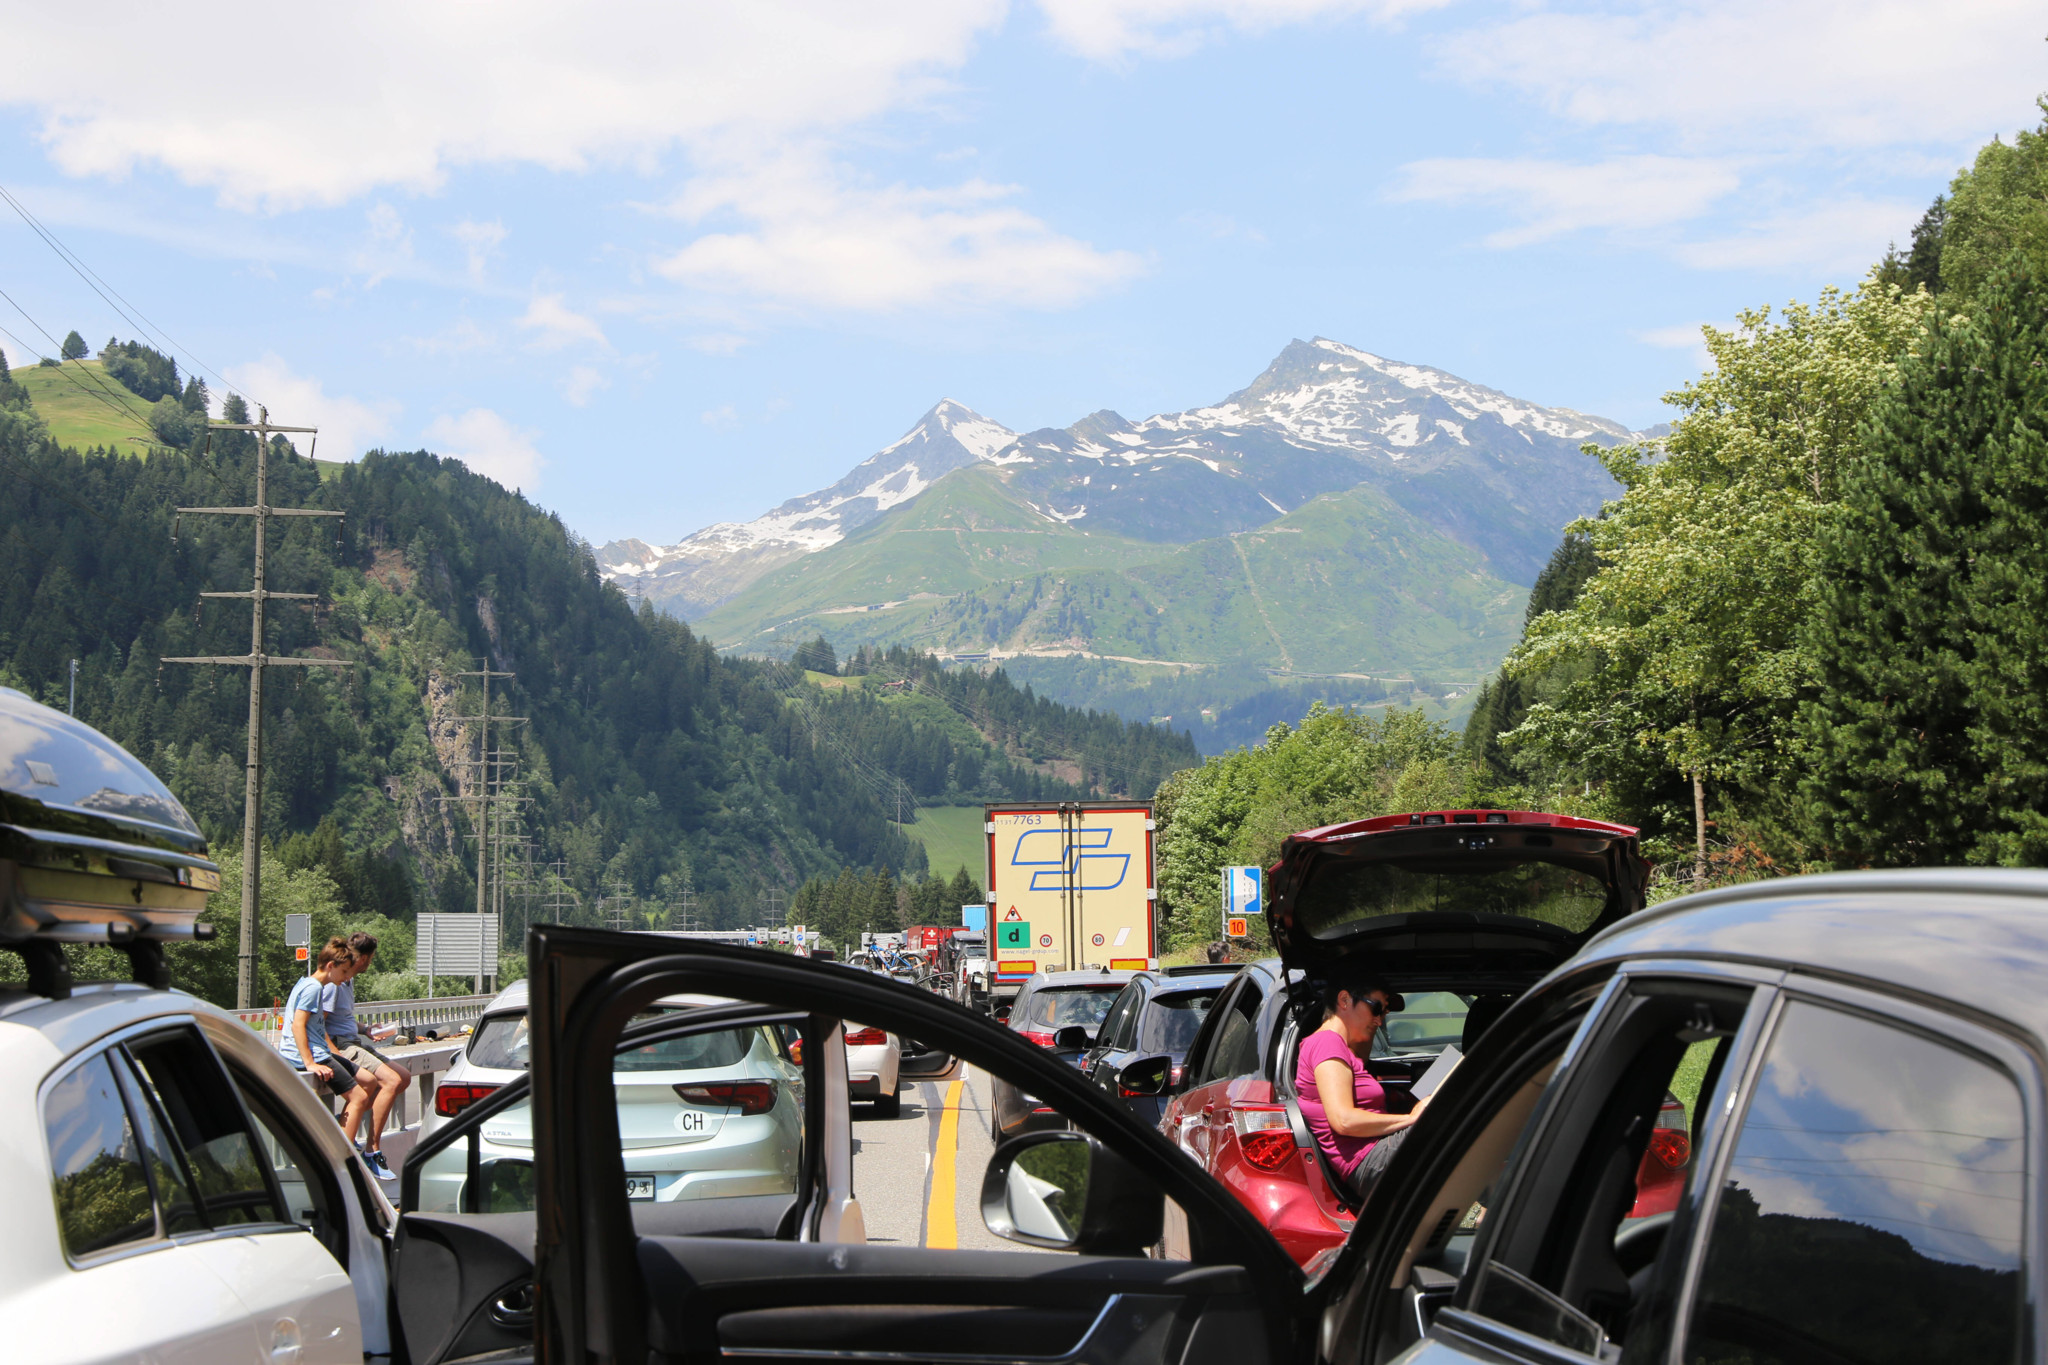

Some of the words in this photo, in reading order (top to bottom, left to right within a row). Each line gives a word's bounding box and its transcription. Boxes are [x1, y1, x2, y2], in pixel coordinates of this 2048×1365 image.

[1232, 922, 1244, 934] 10
[1008, 928, 1020, 942] d
[298, 950, 306, 958] 20
[683, 1113, 704, 1131] CH
